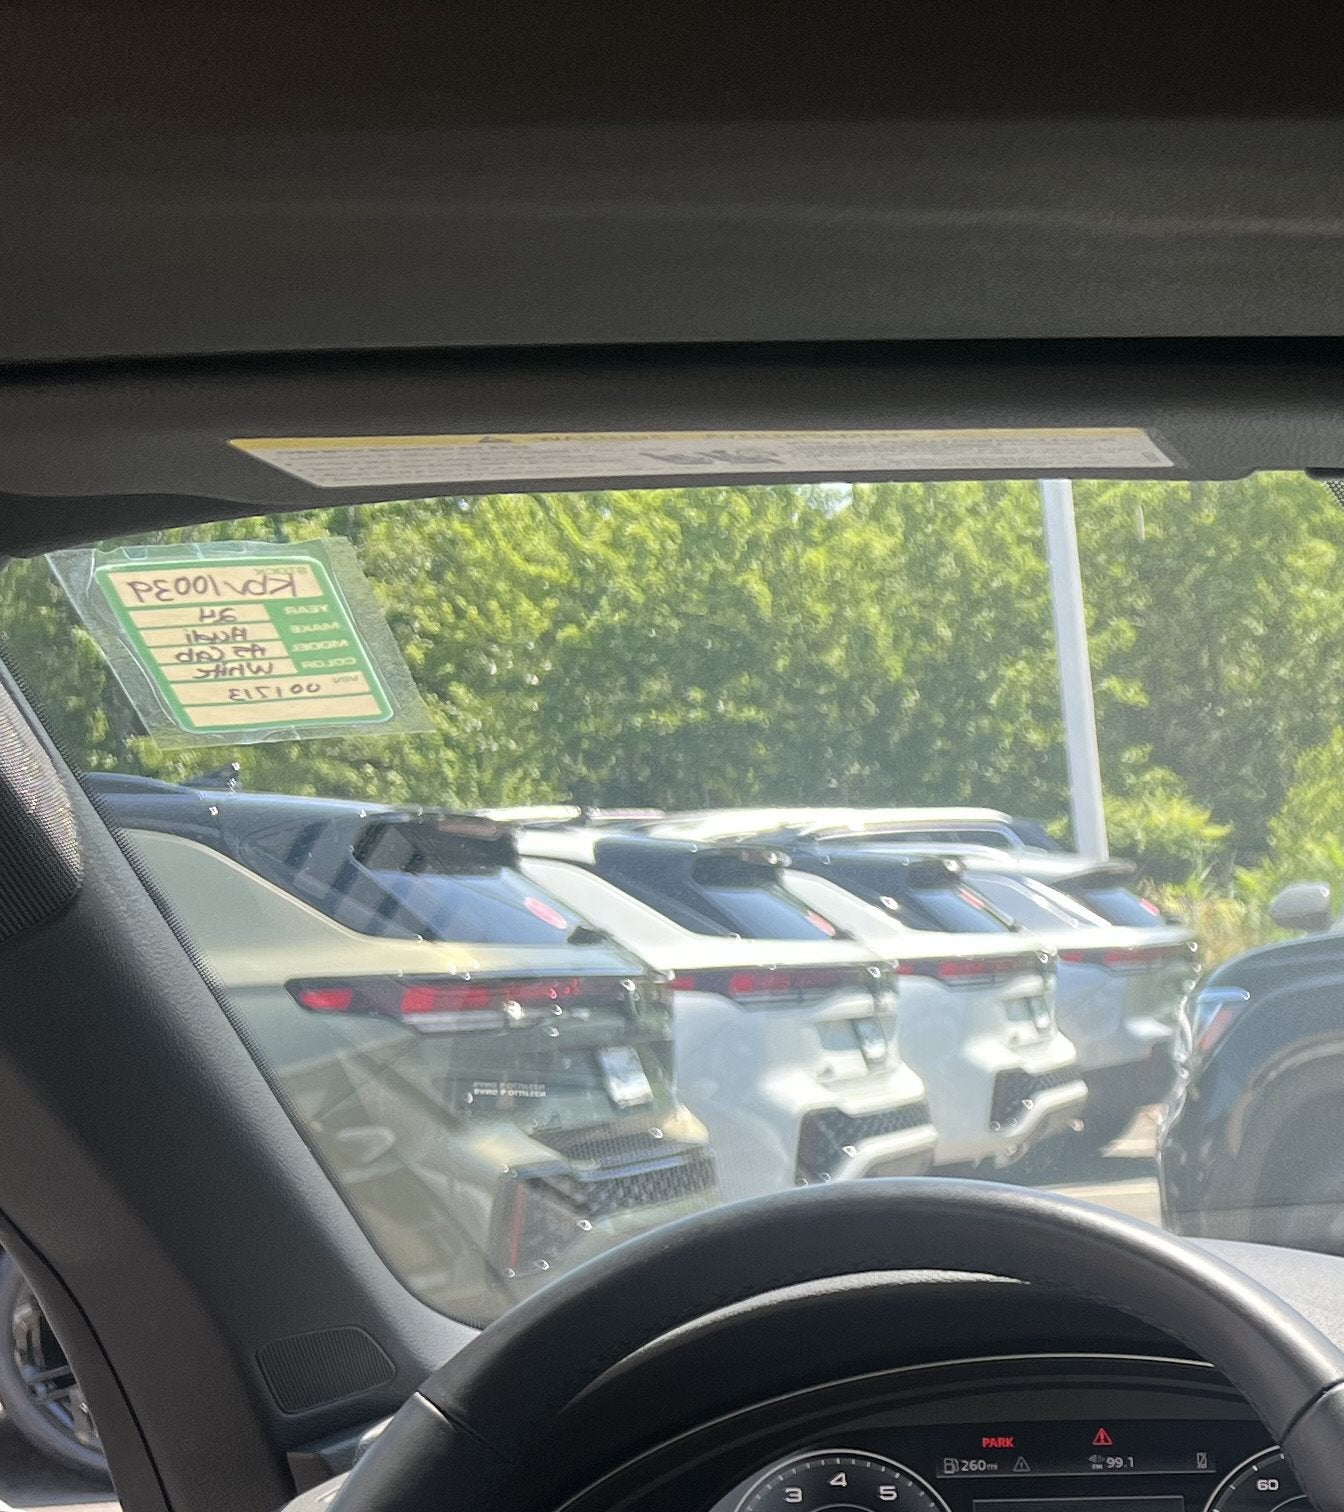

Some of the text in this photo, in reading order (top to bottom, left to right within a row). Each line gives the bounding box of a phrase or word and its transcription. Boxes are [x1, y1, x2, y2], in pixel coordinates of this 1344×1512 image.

[981, 1436, 1015, 1449] PARK
[1106, 1456, 1135, 1469] 99.1
[829, 1472, 848, 1488] 4
[1257, 1478, 1280, 1492] 60
[784, 1488, 803, 1503] 3
[878, 1485, 898, 1501] 5
